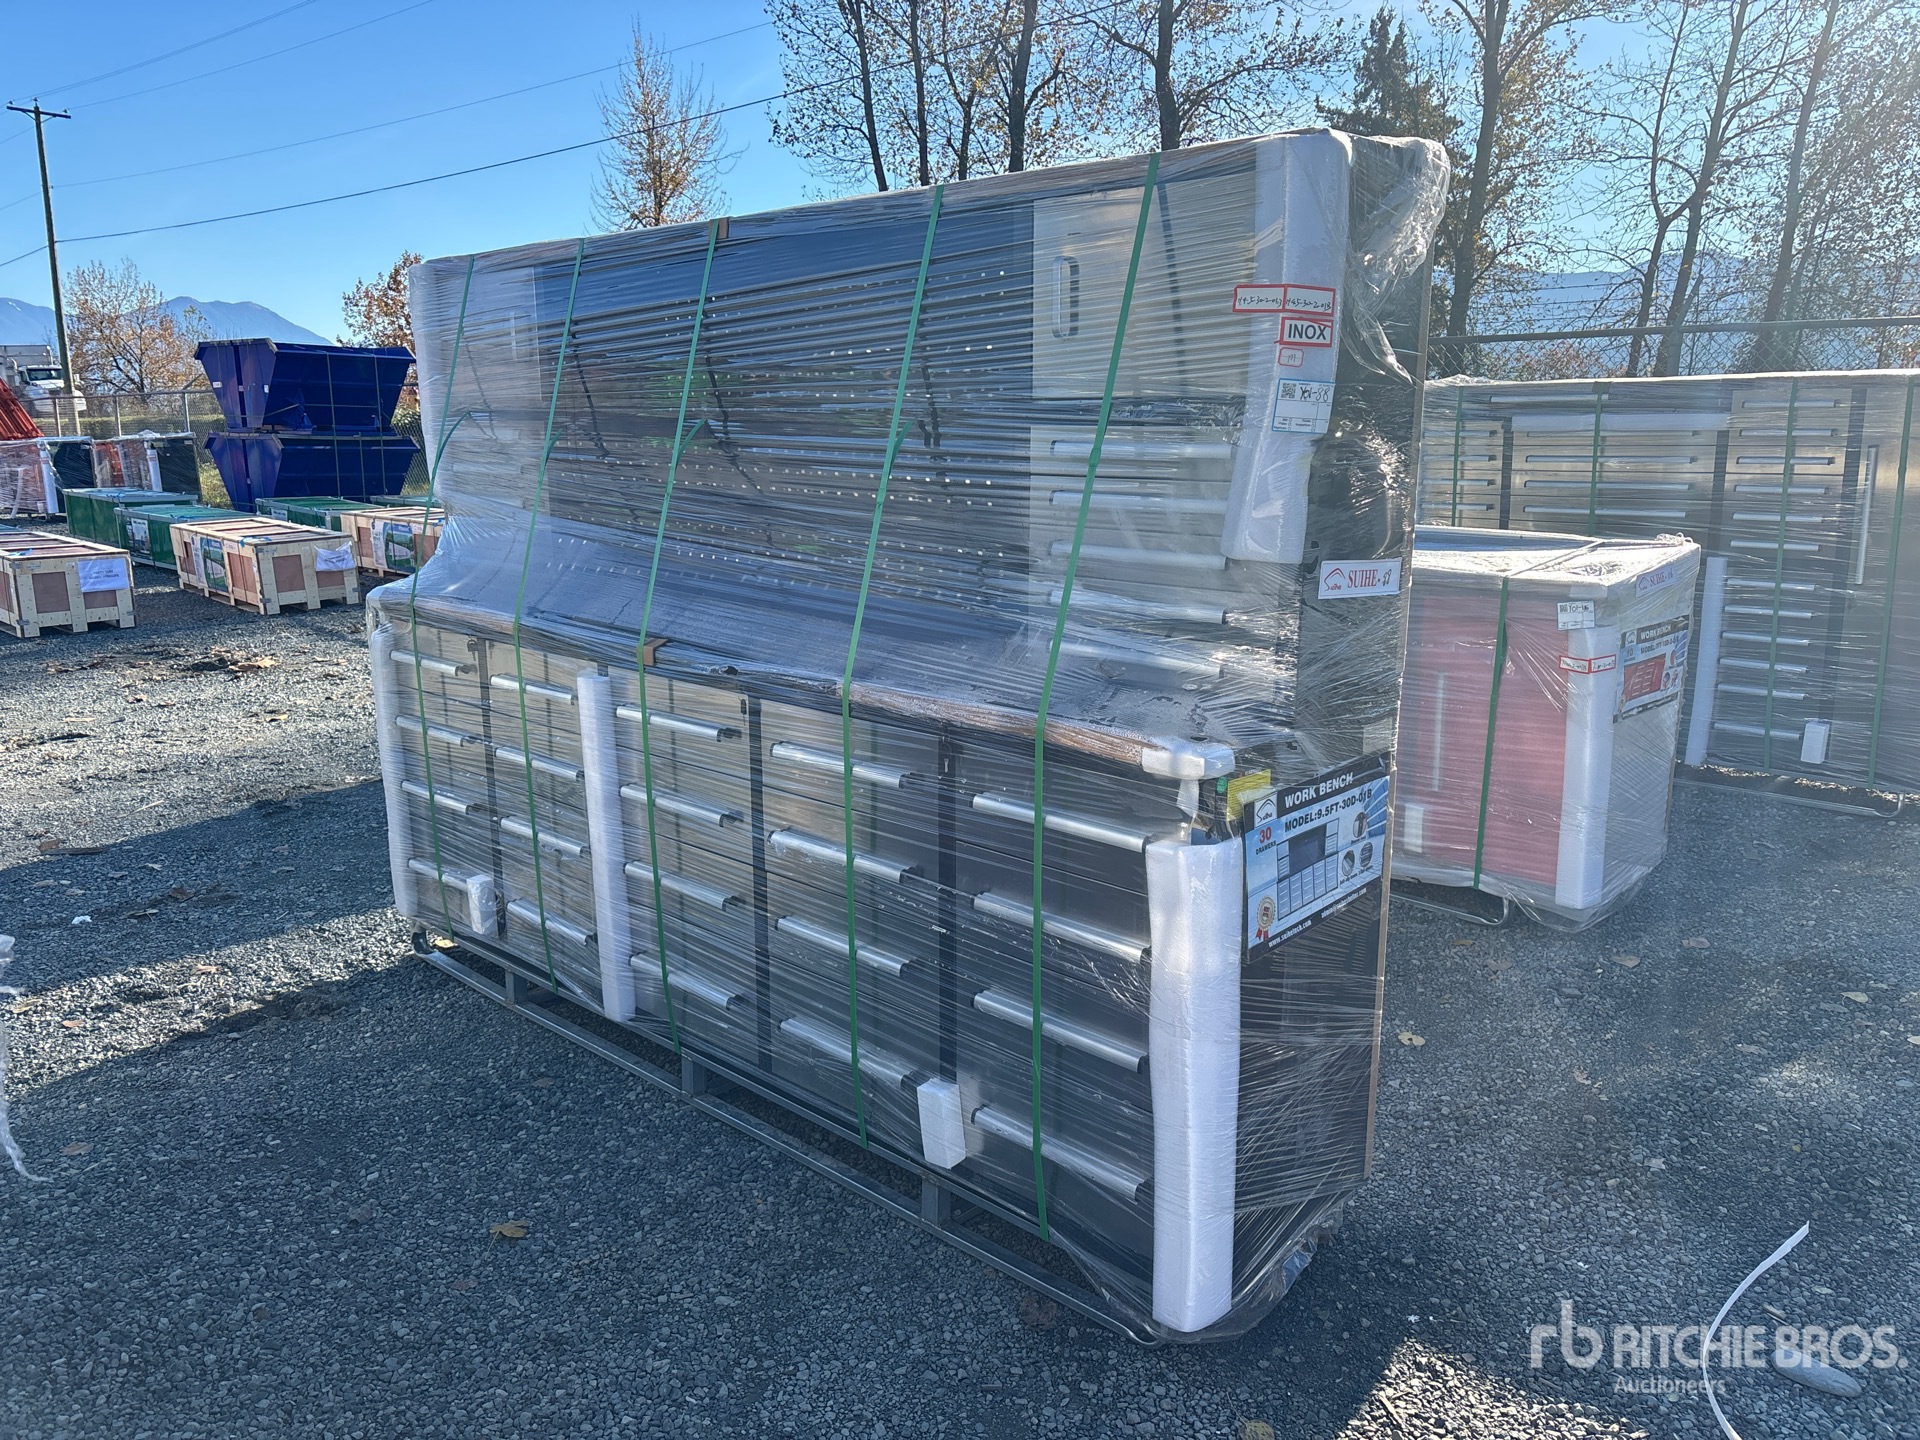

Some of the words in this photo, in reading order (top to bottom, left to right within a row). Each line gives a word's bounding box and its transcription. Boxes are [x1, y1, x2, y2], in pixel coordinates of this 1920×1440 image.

[1287, 323, 1327, 340] INOX
[1640, 630, 1657, 640] WORK
[1285, 786, 1317, 809] WORK
[1319, 772, 1354, 796] BENCH
[1259, 826, 1272, 844] 30
[1255, 840, 1277, 856] DRAWERS
